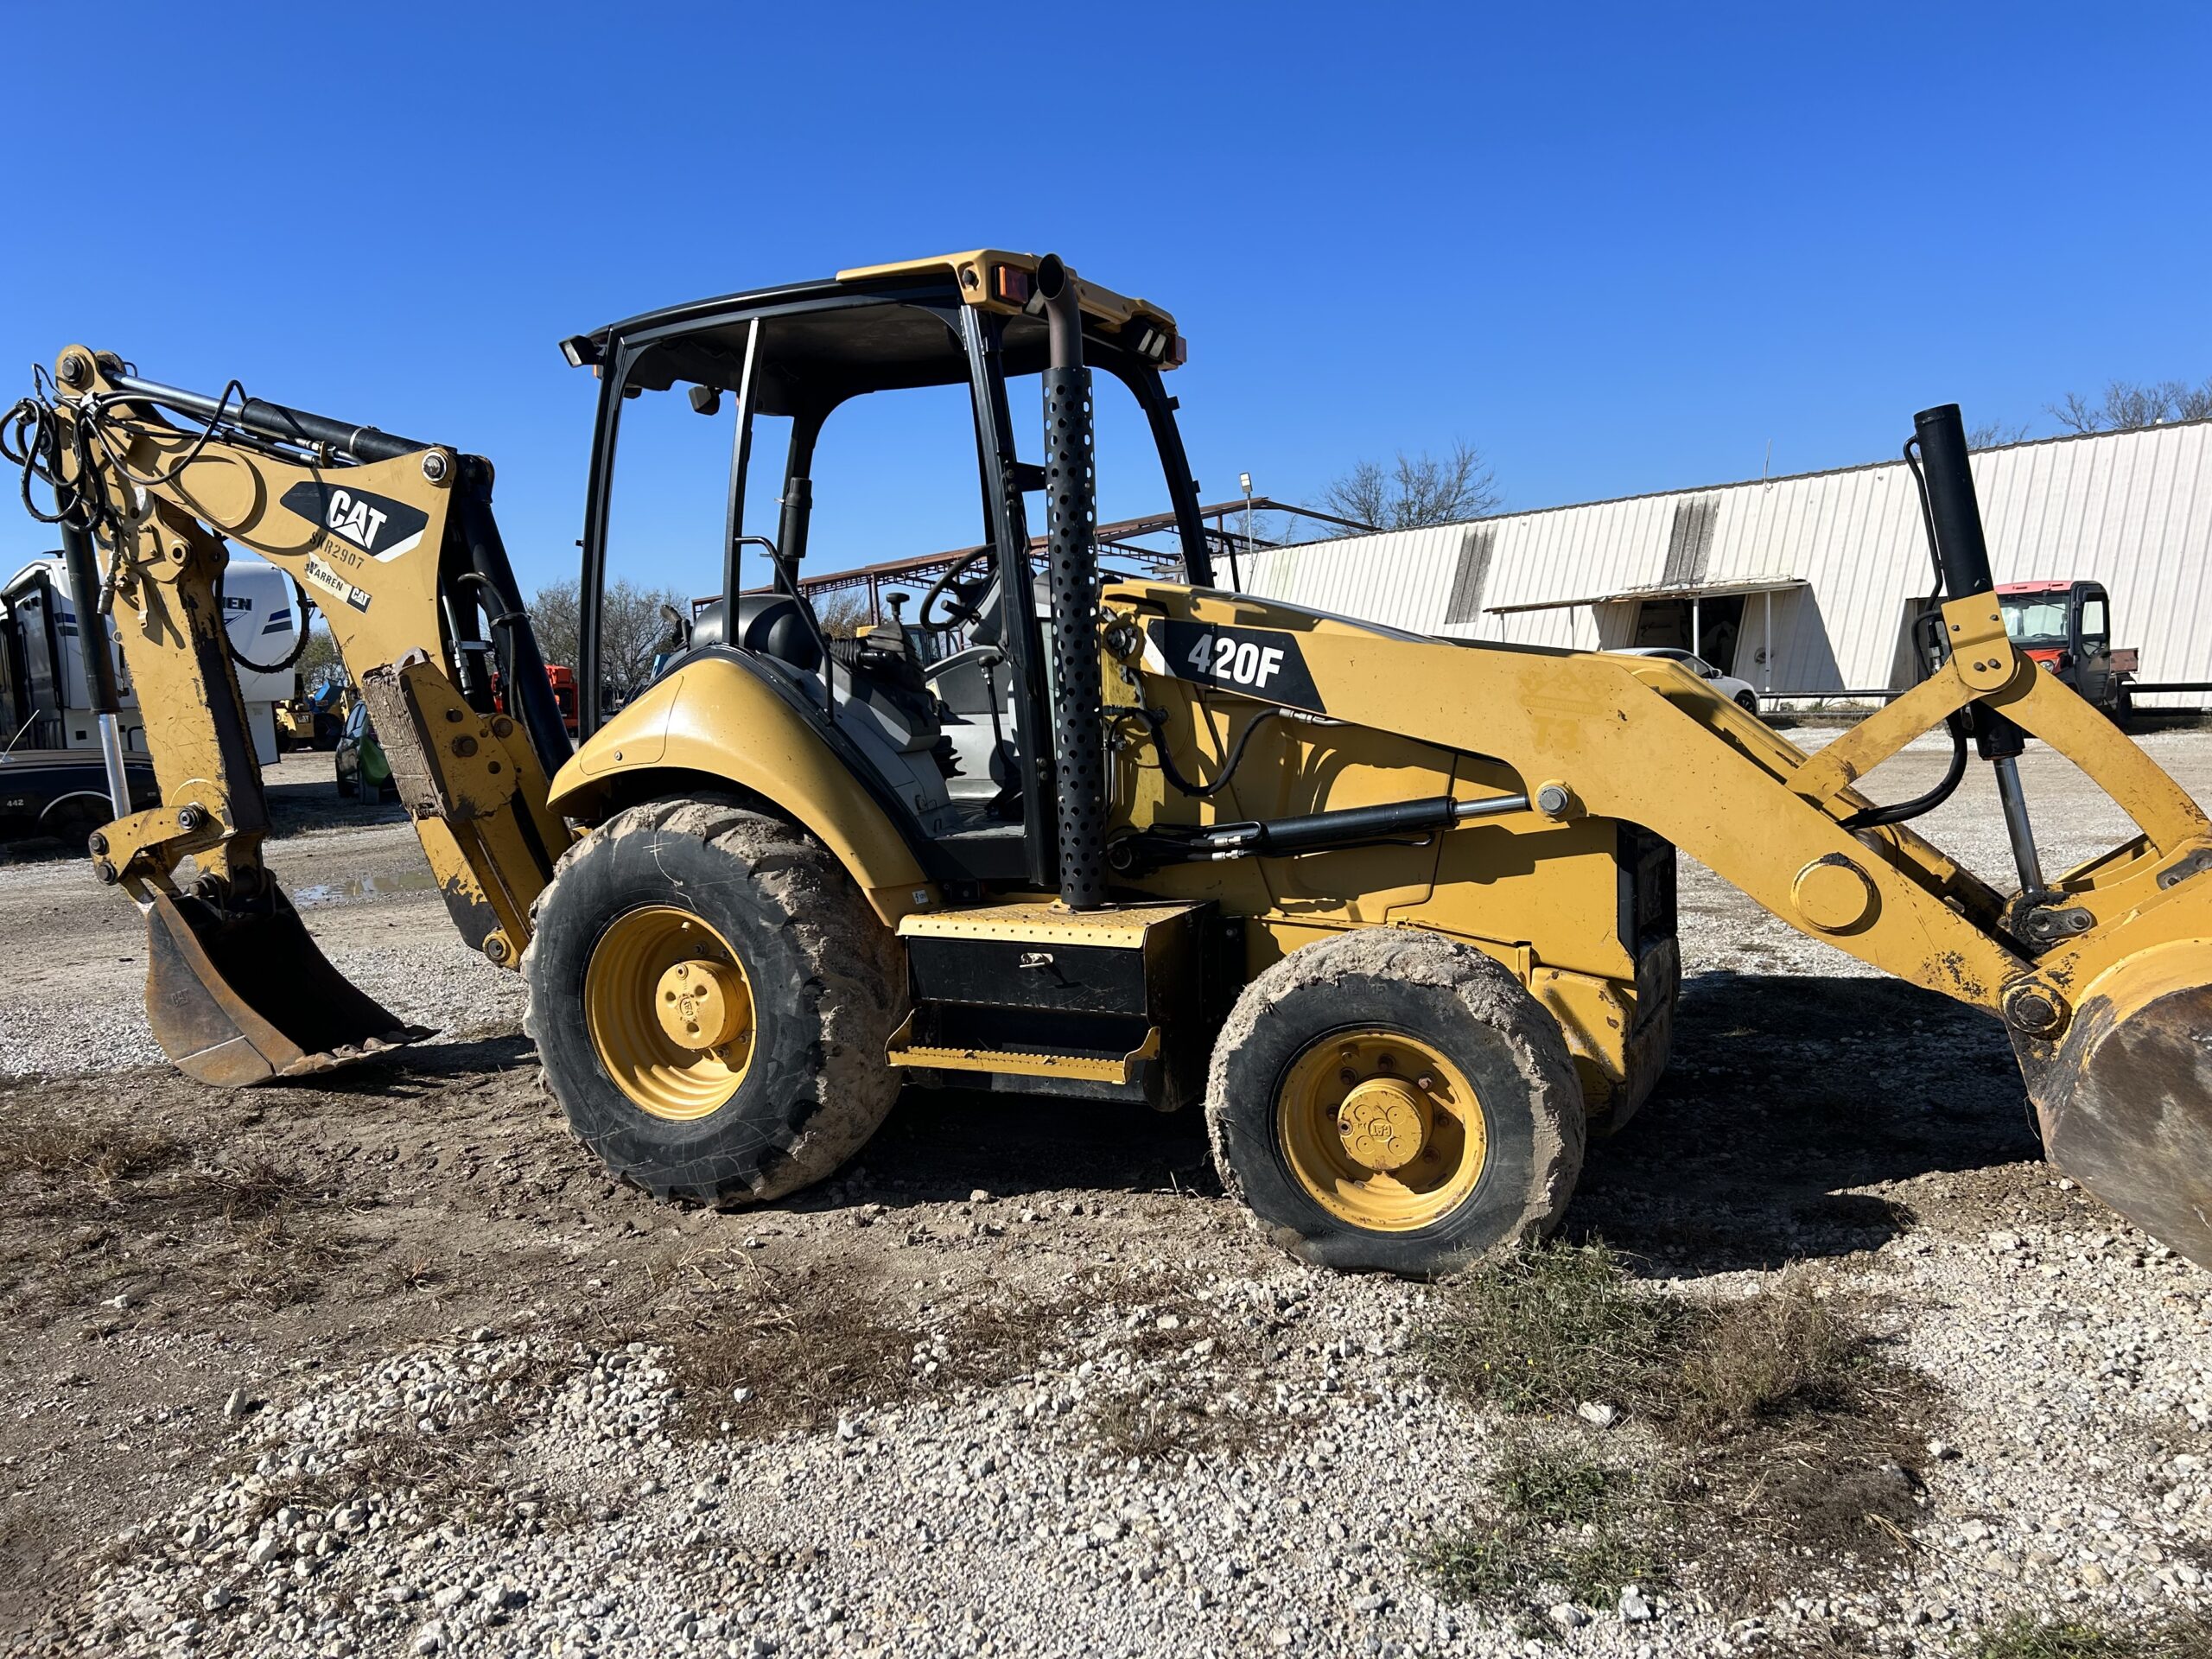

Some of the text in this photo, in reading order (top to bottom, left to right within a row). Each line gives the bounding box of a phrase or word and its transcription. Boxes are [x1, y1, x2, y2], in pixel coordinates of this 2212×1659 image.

[326, 490, 387, 549] CAT
[309, 531, 365, 569] SKR2907
[351, 588, 370, 606] CAT
[1187, 633, 1284, 688] 420F
[1534, 716, 1580, 750] T3
